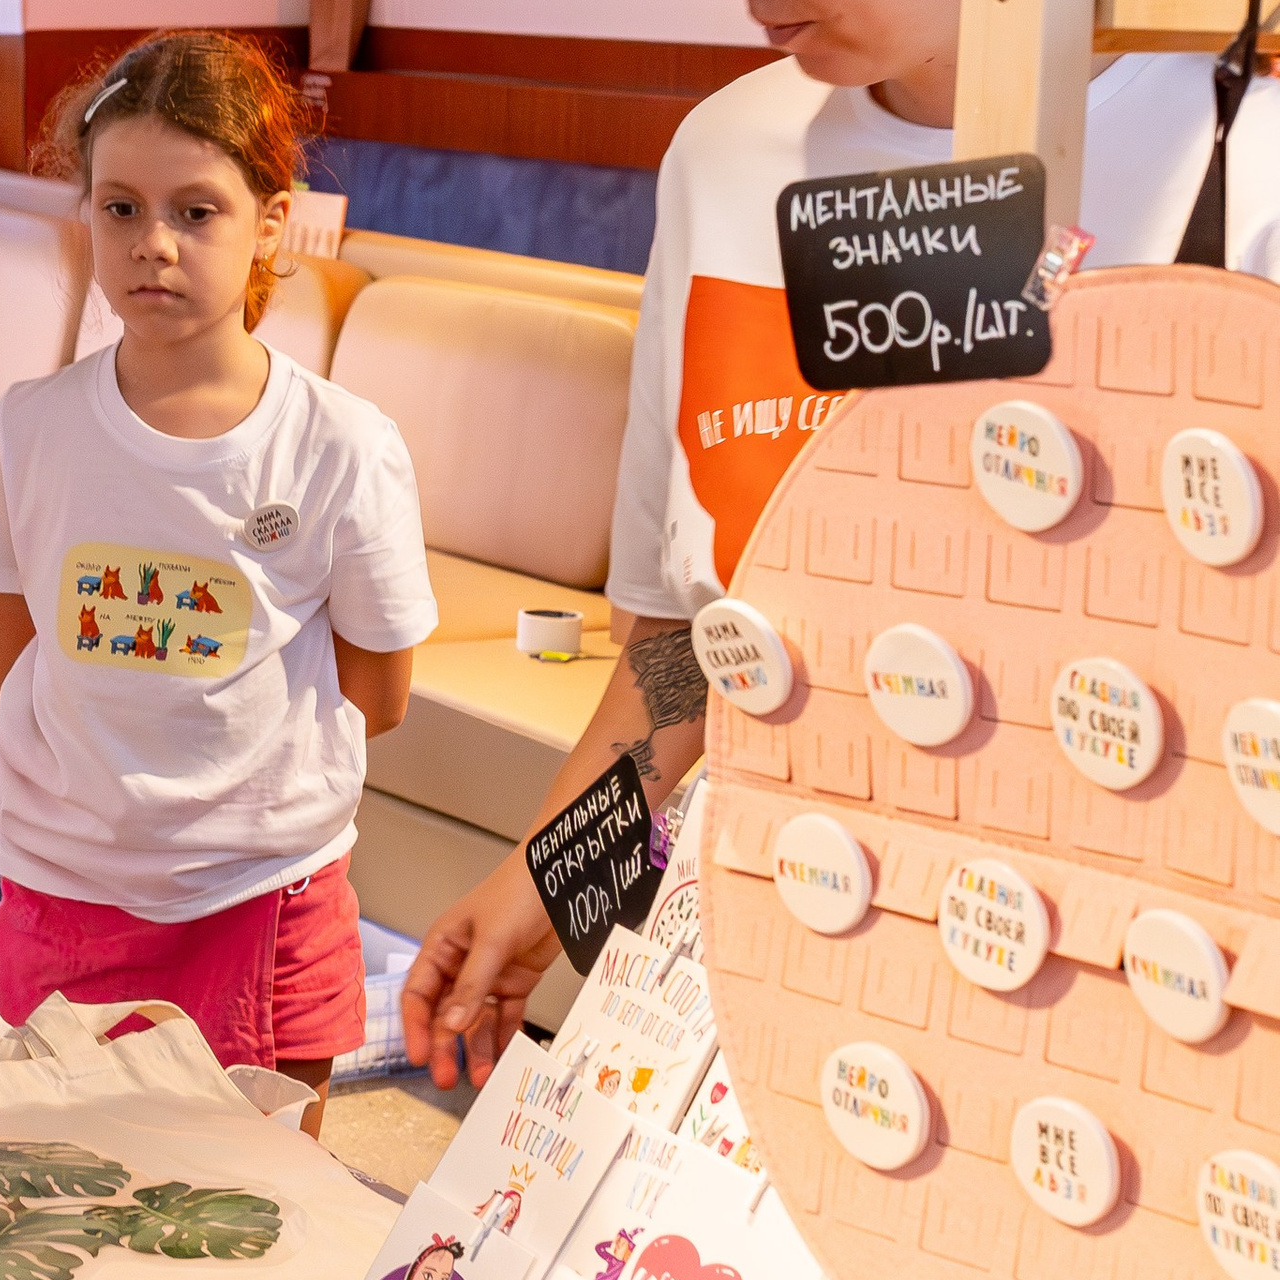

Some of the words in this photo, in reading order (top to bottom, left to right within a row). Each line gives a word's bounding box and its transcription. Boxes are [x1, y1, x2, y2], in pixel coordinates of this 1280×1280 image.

[789, 167, 1023, 232] МЕНТАЛЬНЫЕ
[829, 225, 982, 270] ЗНАЧКИ
[697, 409, 726, 450] НЕ
[732, 396, 794, 440] ИЩУ
[252, 517, 292, 538] СКАЗАЛА
[256, 509, 282, 525] МАМА
[530, 774, 622, 870] МЕНТАЛЬНЫЕ
[544, 792, 642, 898] ОТКРЫТКИ
[515, 1066, 583, 1123] ЦАРИЦА
[500, 1109, 584, 1181] ИСТЕРИЦА
